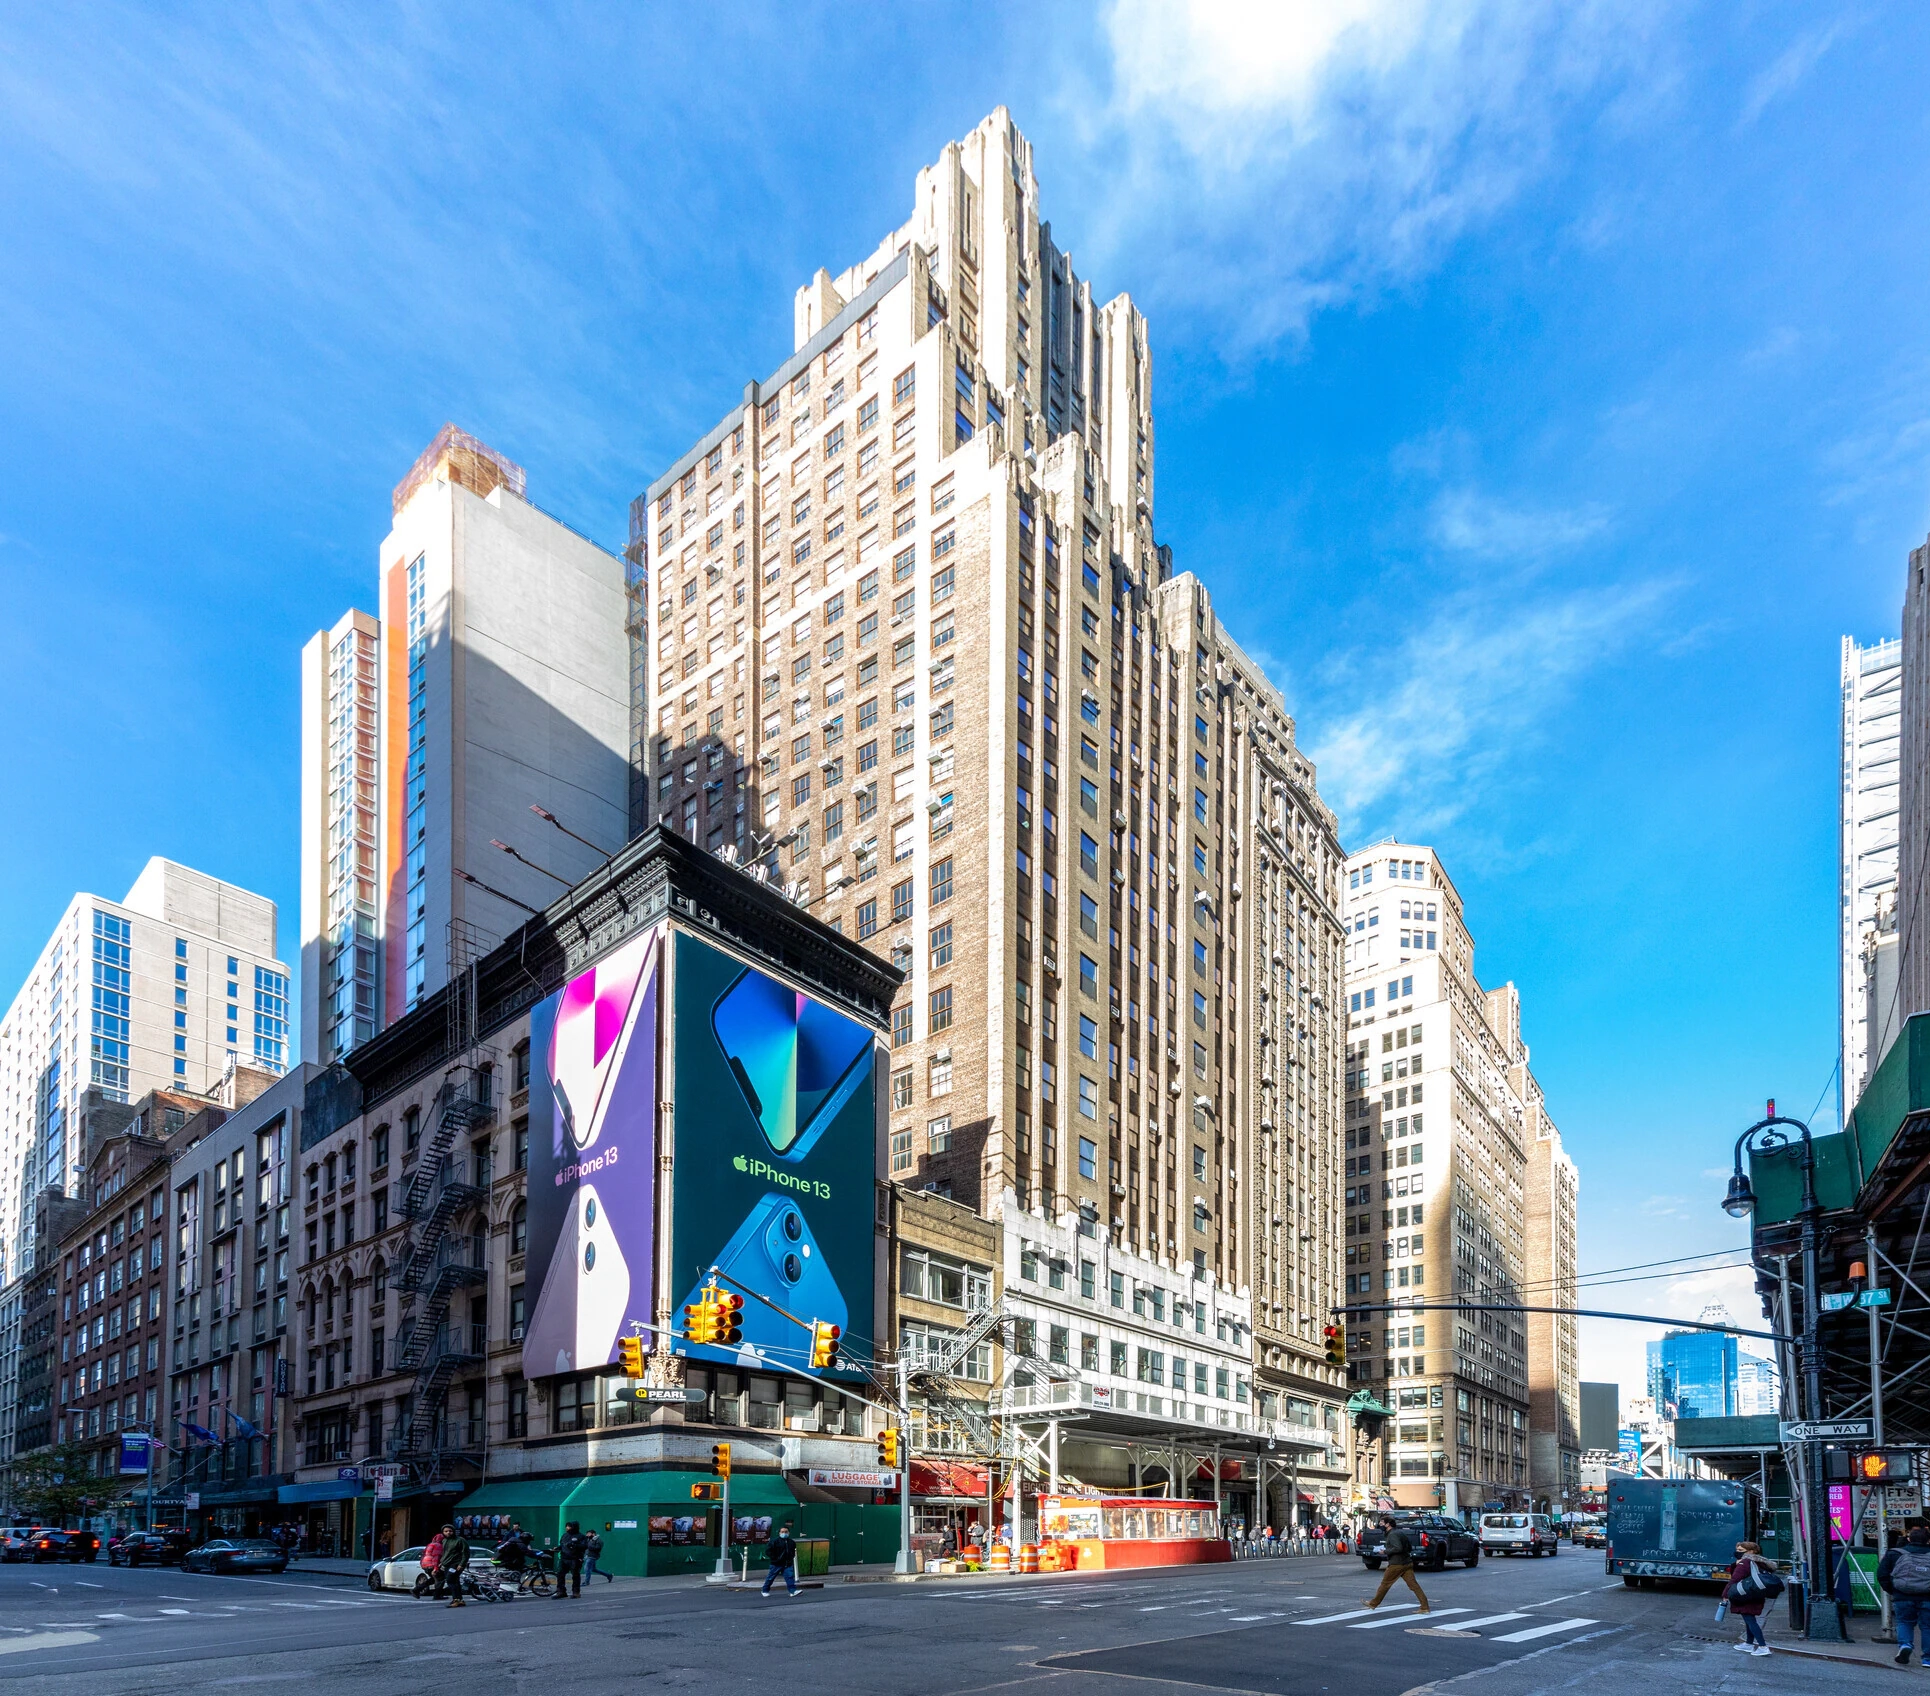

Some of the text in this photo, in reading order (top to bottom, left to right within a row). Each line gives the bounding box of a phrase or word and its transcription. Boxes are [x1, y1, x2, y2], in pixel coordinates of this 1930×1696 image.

[564, 1146, 618, 1184] iPhone 13
[749, 1158, 831, 1200] iPhone 13
[1860, 1292, 1874, 1305] 37
[846, 1363, 864, 1373] AT&
[648, 1390, 687, 1399] PEARL
[1794, 1424, 1862, 1436] ONE WAY
[831, 1472, 879, 1481] LUGGAGE
[1023, 1481, 1050, 1493] EIGHTH
[1057, 1484, 1082, 1495] VENUE
